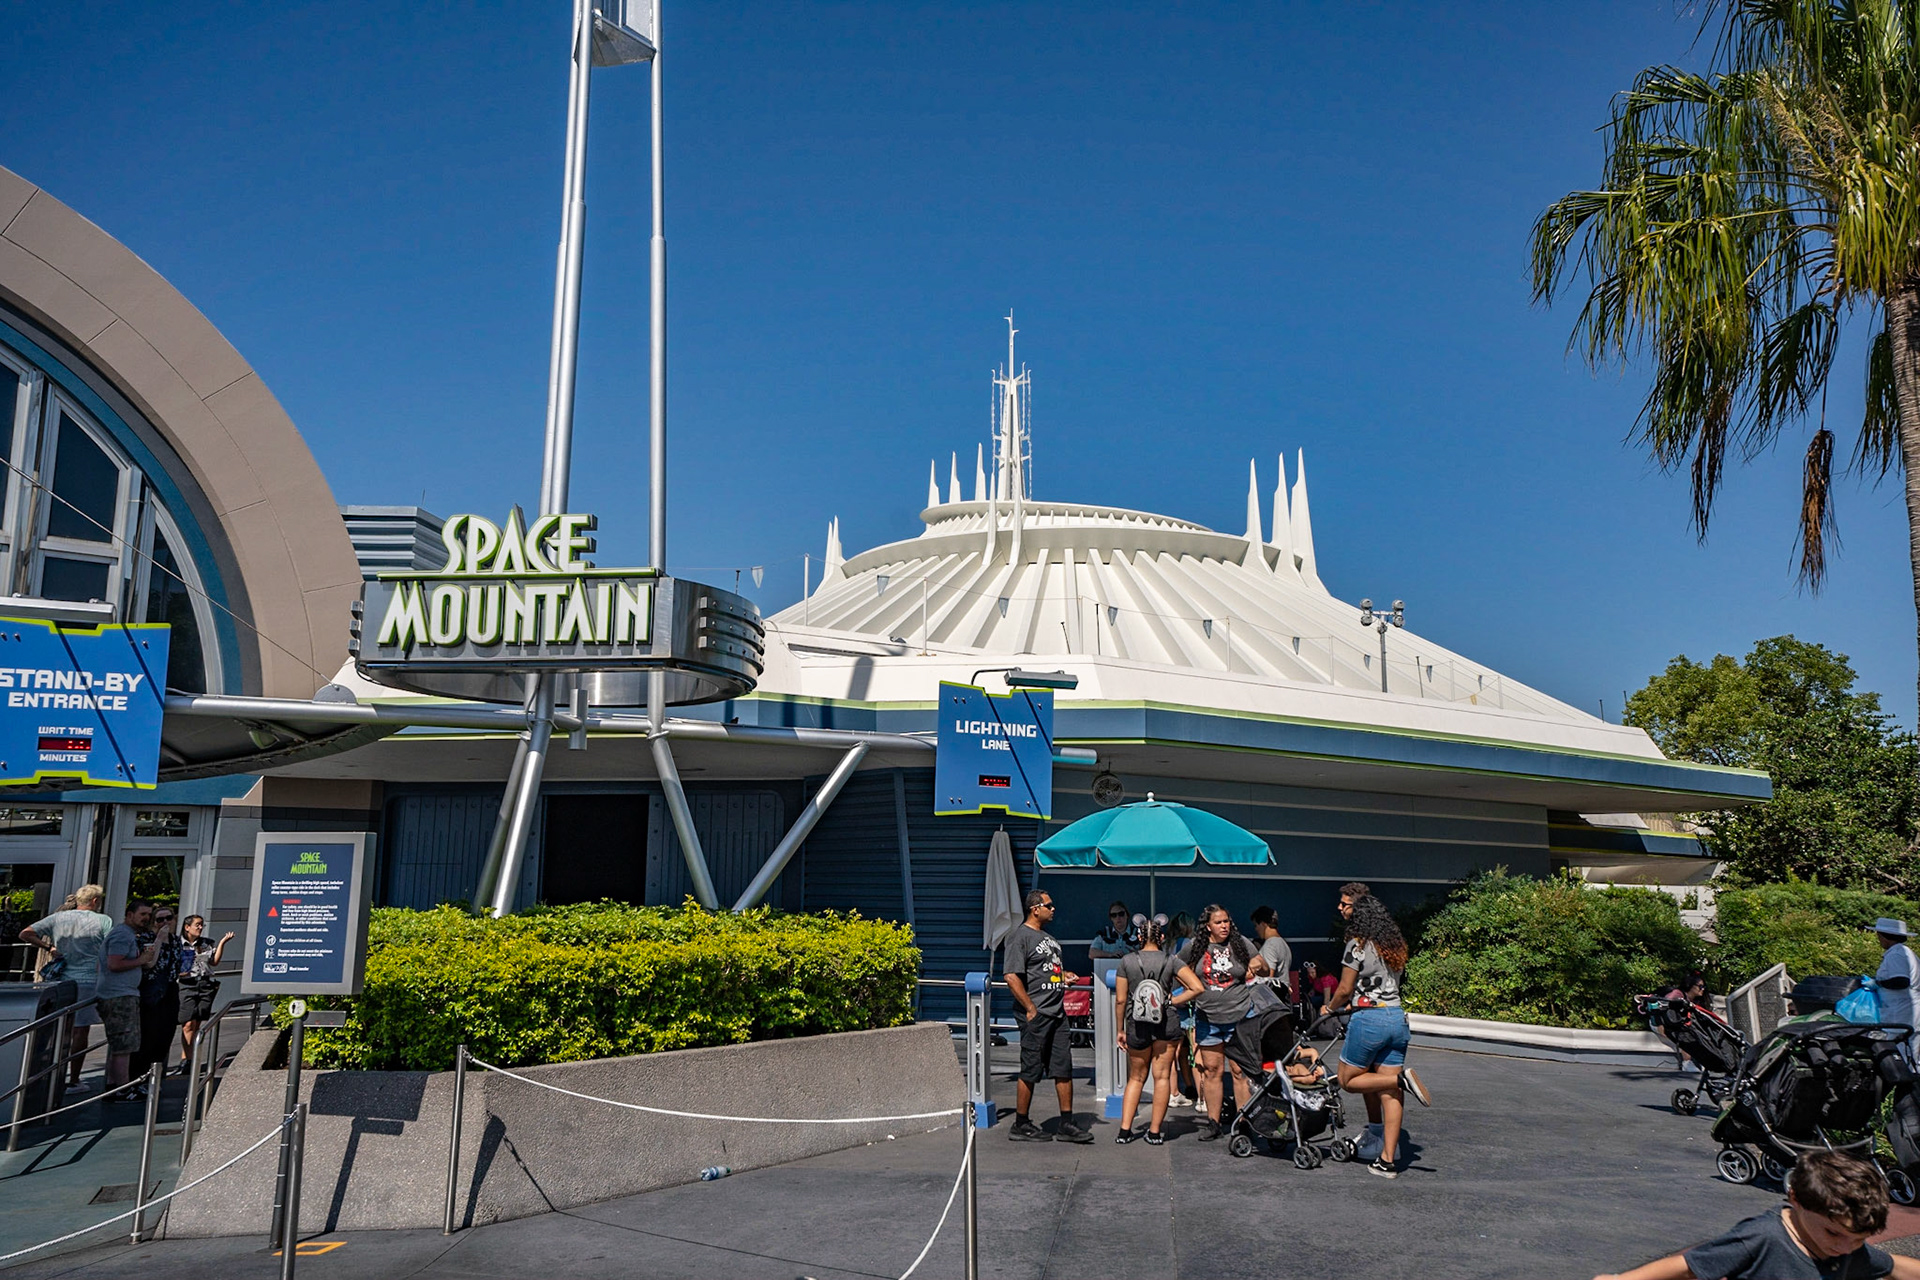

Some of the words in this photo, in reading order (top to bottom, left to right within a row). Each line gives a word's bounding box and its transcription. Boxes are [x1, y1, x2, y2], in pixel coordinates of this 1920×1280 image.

[442, 507, 595, 573] SPACE
[377, 577, 655, 653] MOUNTAIN
[0, 668, 144, 692] STAND-BY
[8, 692, 128, 711] ENTRANCE
[38, 726, 66, 735] WAIT
[68, 727, 94, 736] TIME
[955, 720, 1037, 738] LIGHTNING
[982, 739, 1010, 750] LANE
[39, 754, 87, 762] MINUTES
[300, 852, 320, 862] SPACE
[290, 863, 327, 874] MOUNTAIN
